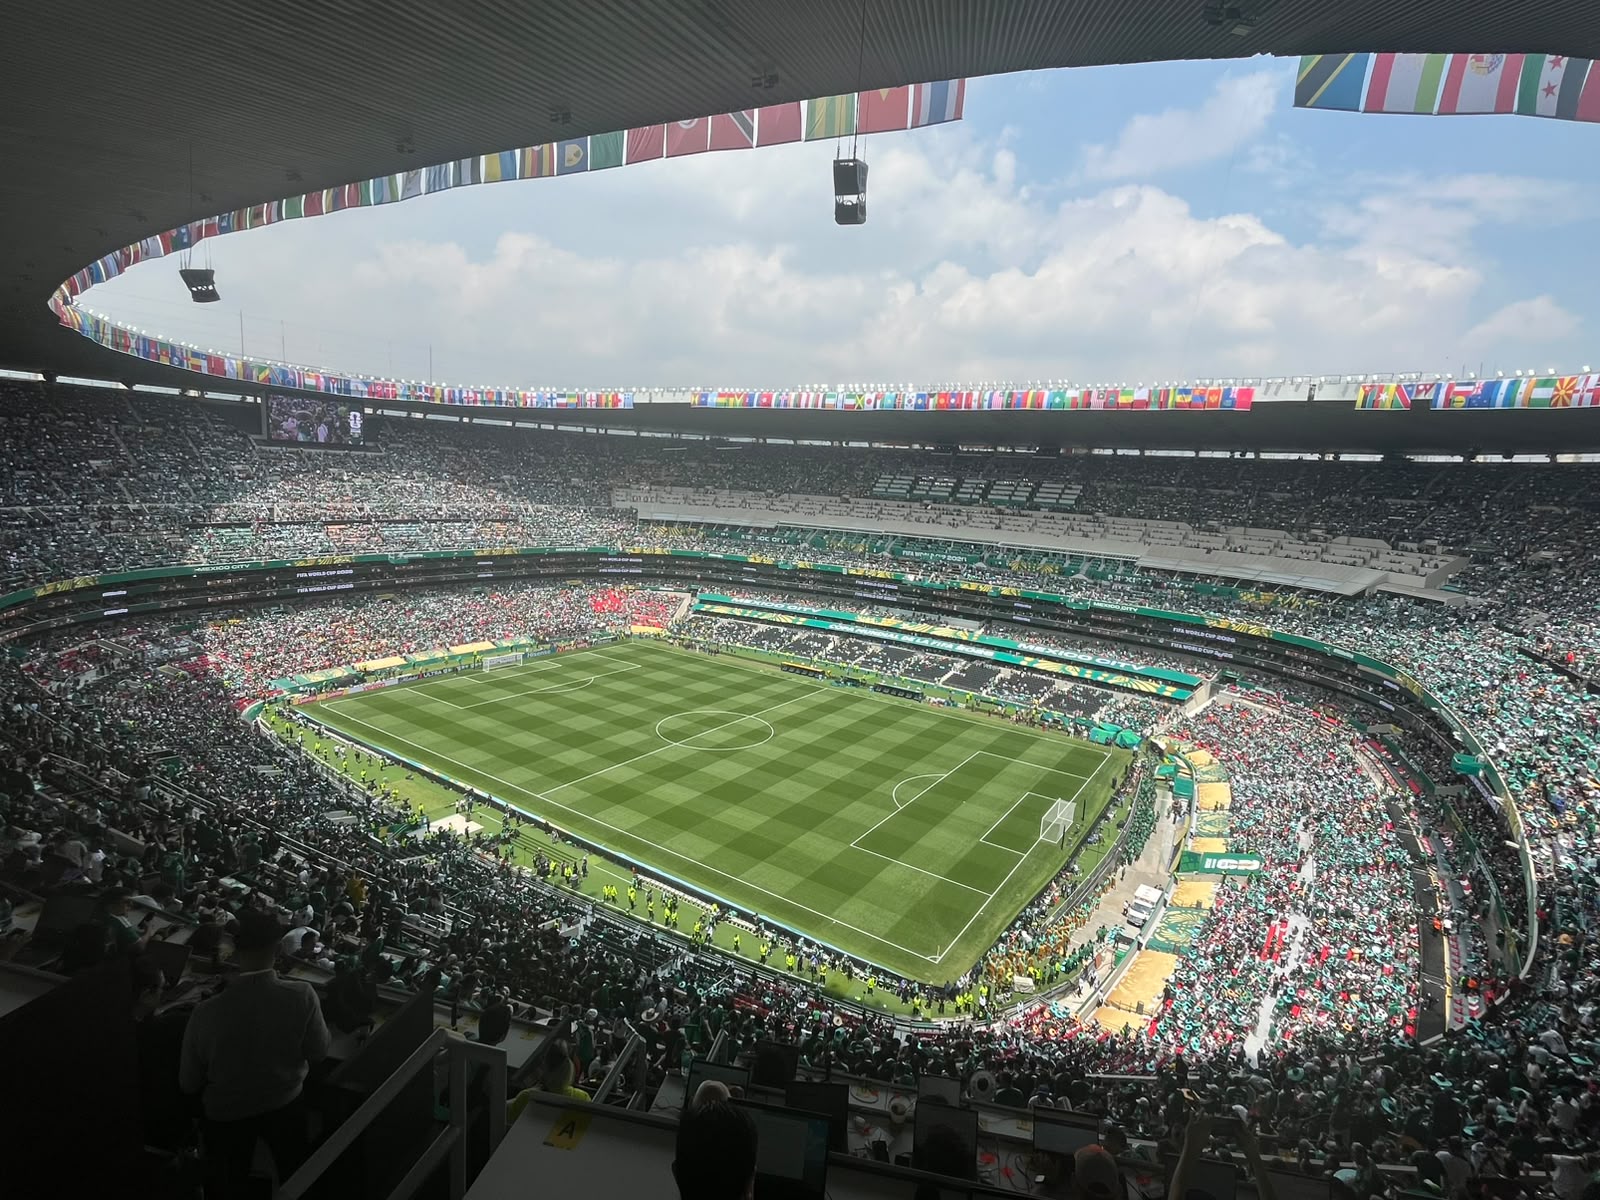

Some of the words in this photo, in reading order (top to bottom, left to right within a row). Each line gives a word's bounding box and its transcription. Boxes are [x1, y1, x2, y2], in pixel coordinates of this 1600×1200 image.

[731, 597, 786, 609] MEXICO
[786, 604, 824, 613] CITY
[1093, 602, 1119, 610] MEXICO
[1120, 605, 1138, 613] CITY
[829, 624, 855, 633] COPA
[854, 626, 899, 640] MUNDIAL
[915, 637, 930, 645] LA
[931, 639, 954, 649] FIFA
[1185, 629, 1205, 637] WORLD
[1205, 632, 1216, 640] CUP
[1183, 644, 1202, 652] WORLD
[1016, 642, 1093, 662] MEXICO
[1094, 657, 1147, 671] CITY
[557, 1119, 576, 1139] A
